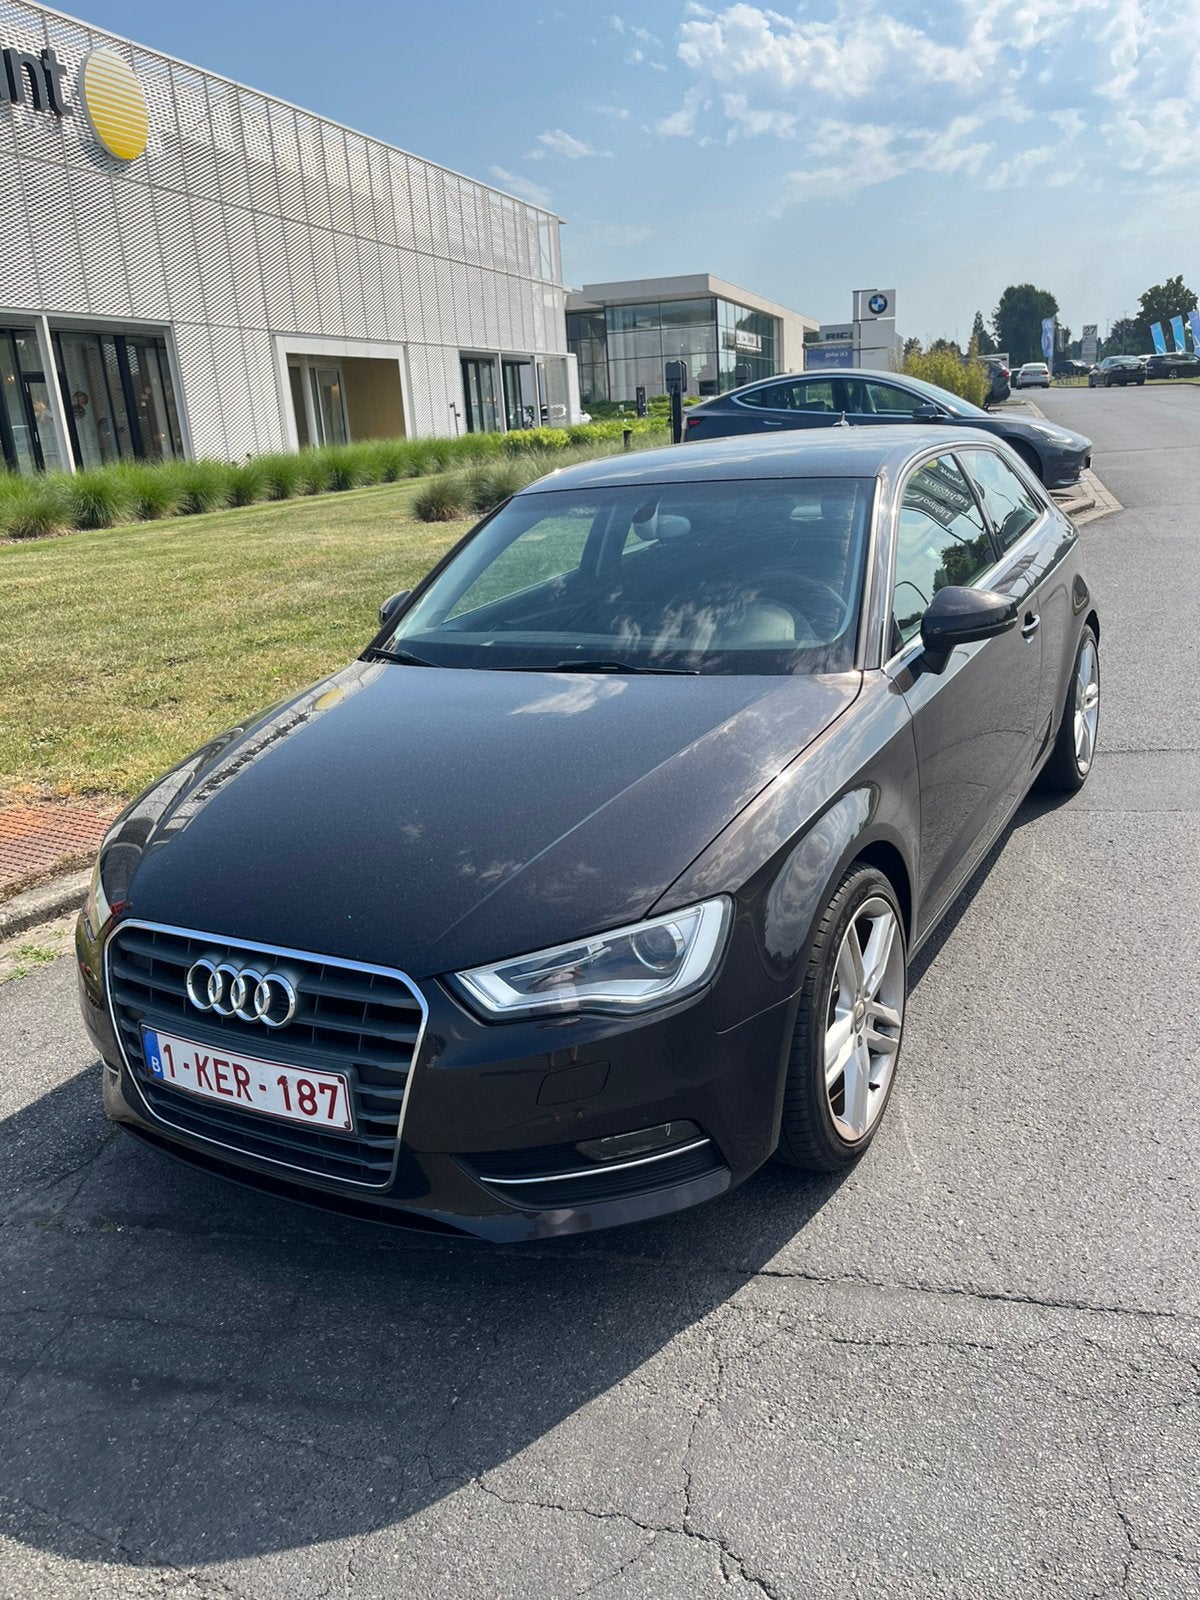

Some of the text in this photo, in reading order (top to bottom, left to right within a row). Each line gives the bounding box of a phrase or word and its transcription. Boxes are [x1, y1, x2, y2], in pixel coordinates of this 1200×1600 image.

[1083, 327, 1096, 336] 27
[151, 1055, 161, 1073] B
[163, 1043, 339, 1120] 1-KER-187
